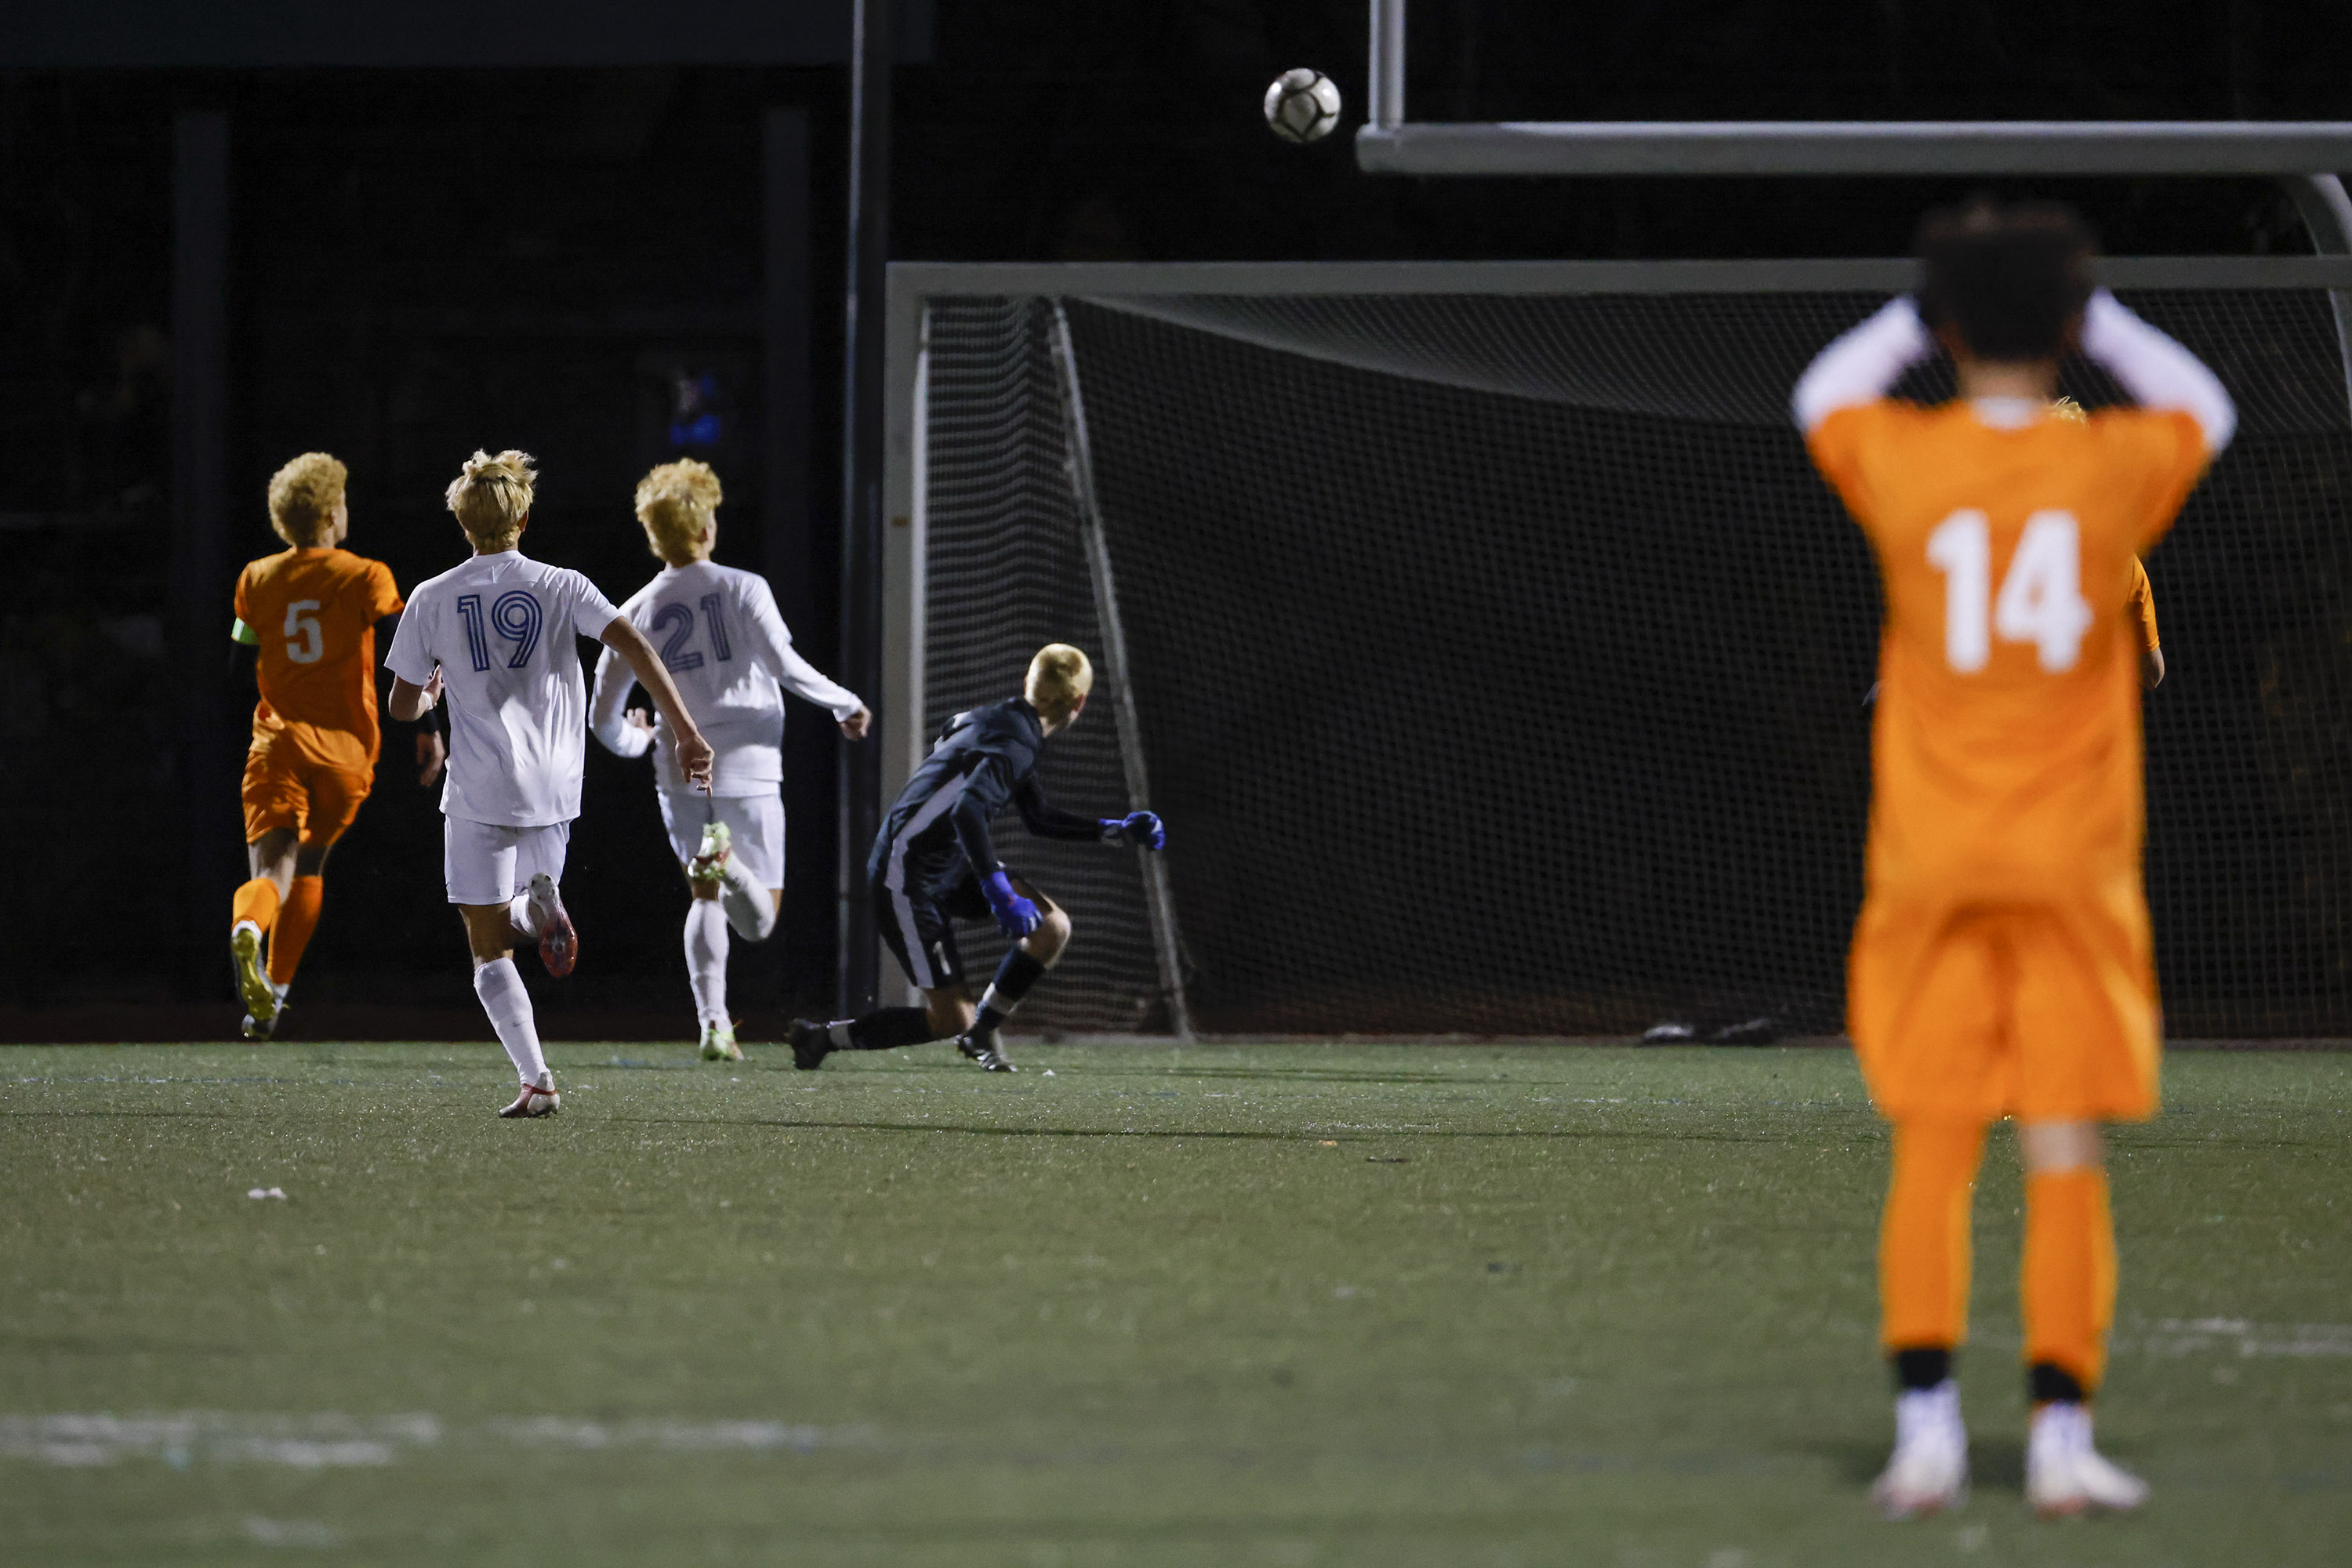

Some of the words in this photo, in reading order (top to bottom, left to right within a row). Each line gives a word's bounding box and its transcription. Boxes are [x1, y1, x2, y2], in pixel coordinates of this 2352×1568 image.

[1926, 507, 2094, 675] 14
[283, 599, 324, 664] 5
[457, 590, 543, 672] 19
[652, 593, 731, 672] 21
[932, 940, 952, 975] 1
